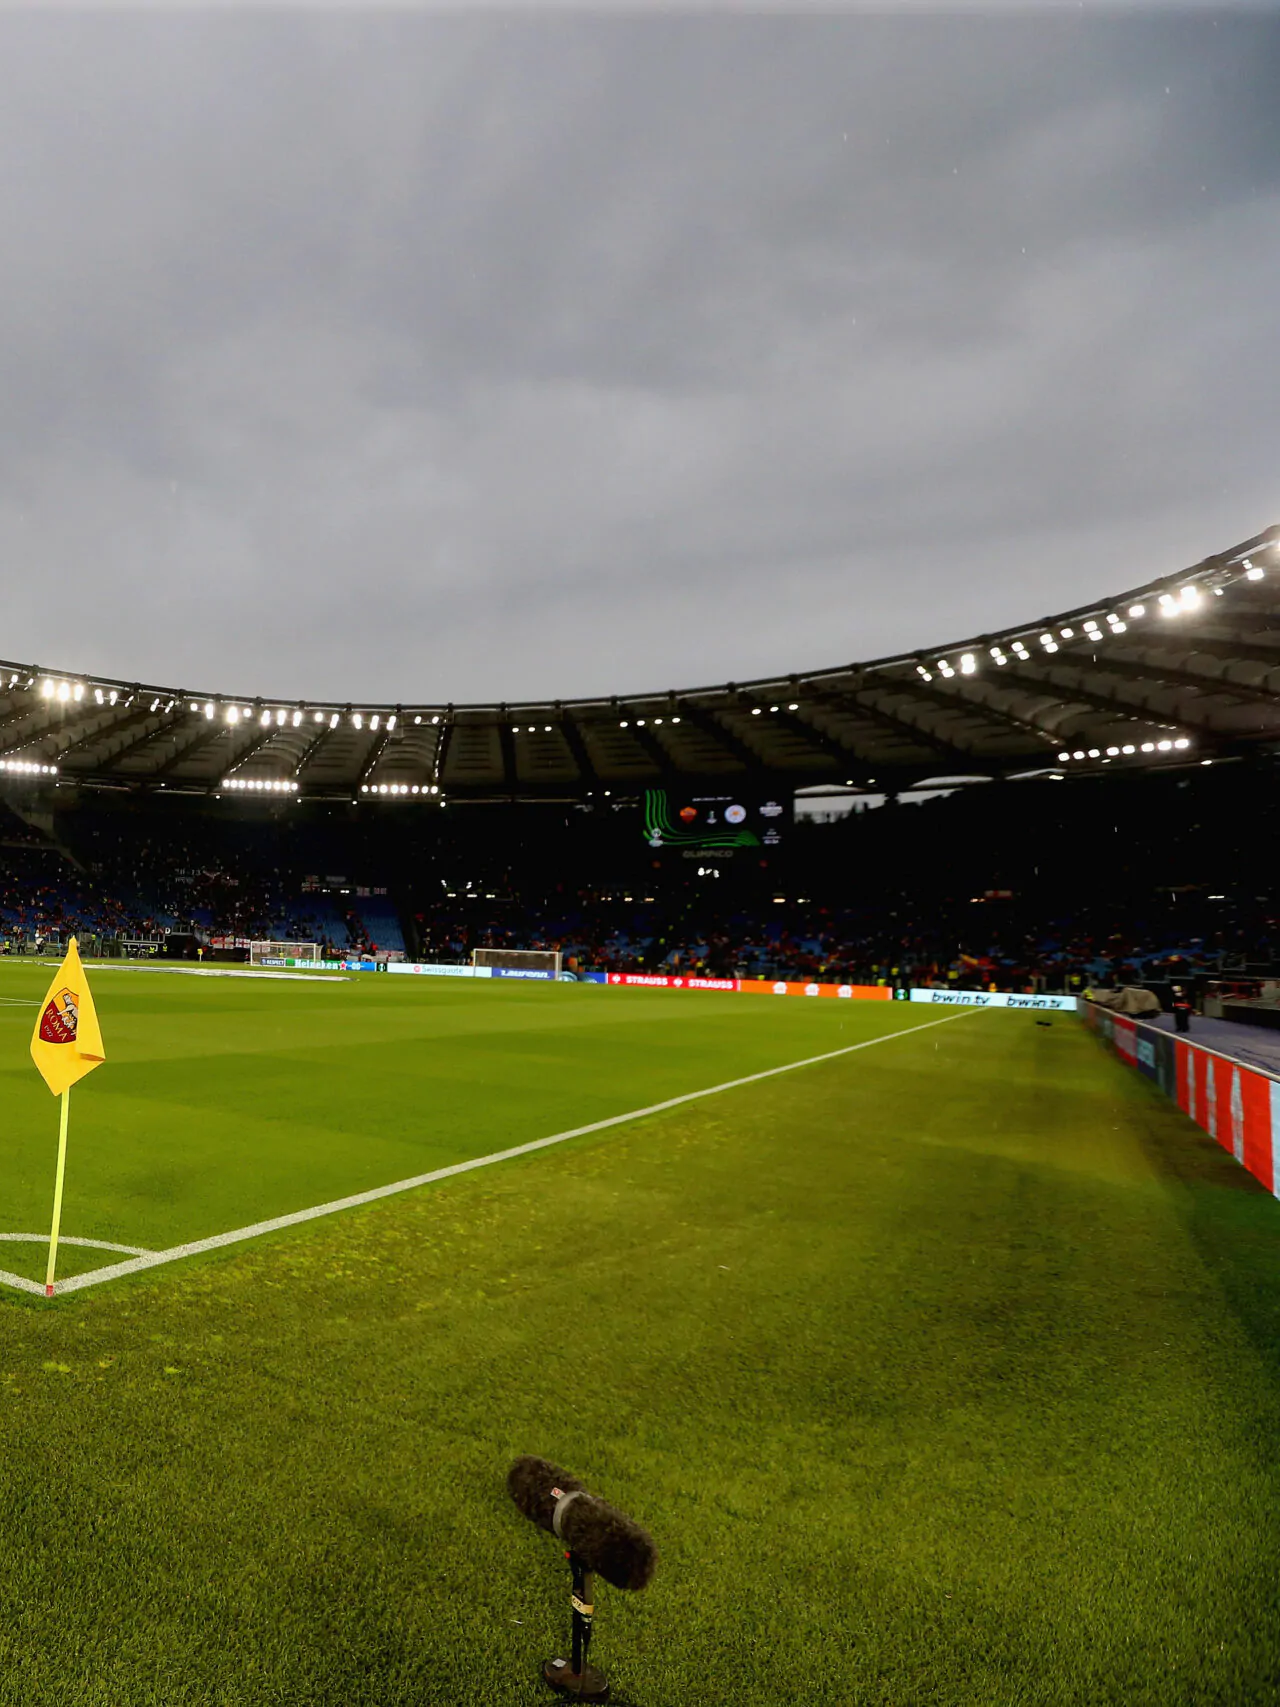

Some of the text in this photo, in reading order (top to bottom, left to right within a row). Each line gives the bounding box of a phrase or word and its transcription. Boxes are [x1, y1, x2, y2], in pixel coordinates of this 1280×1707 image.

[682, 849, 735, 859] OLIMPICO
[295, 959, 339, 970] Heineken
[626, 975, 734, 989] STRAUSS STRAUSS
[45, 1009, 68, 1042] ROMA
